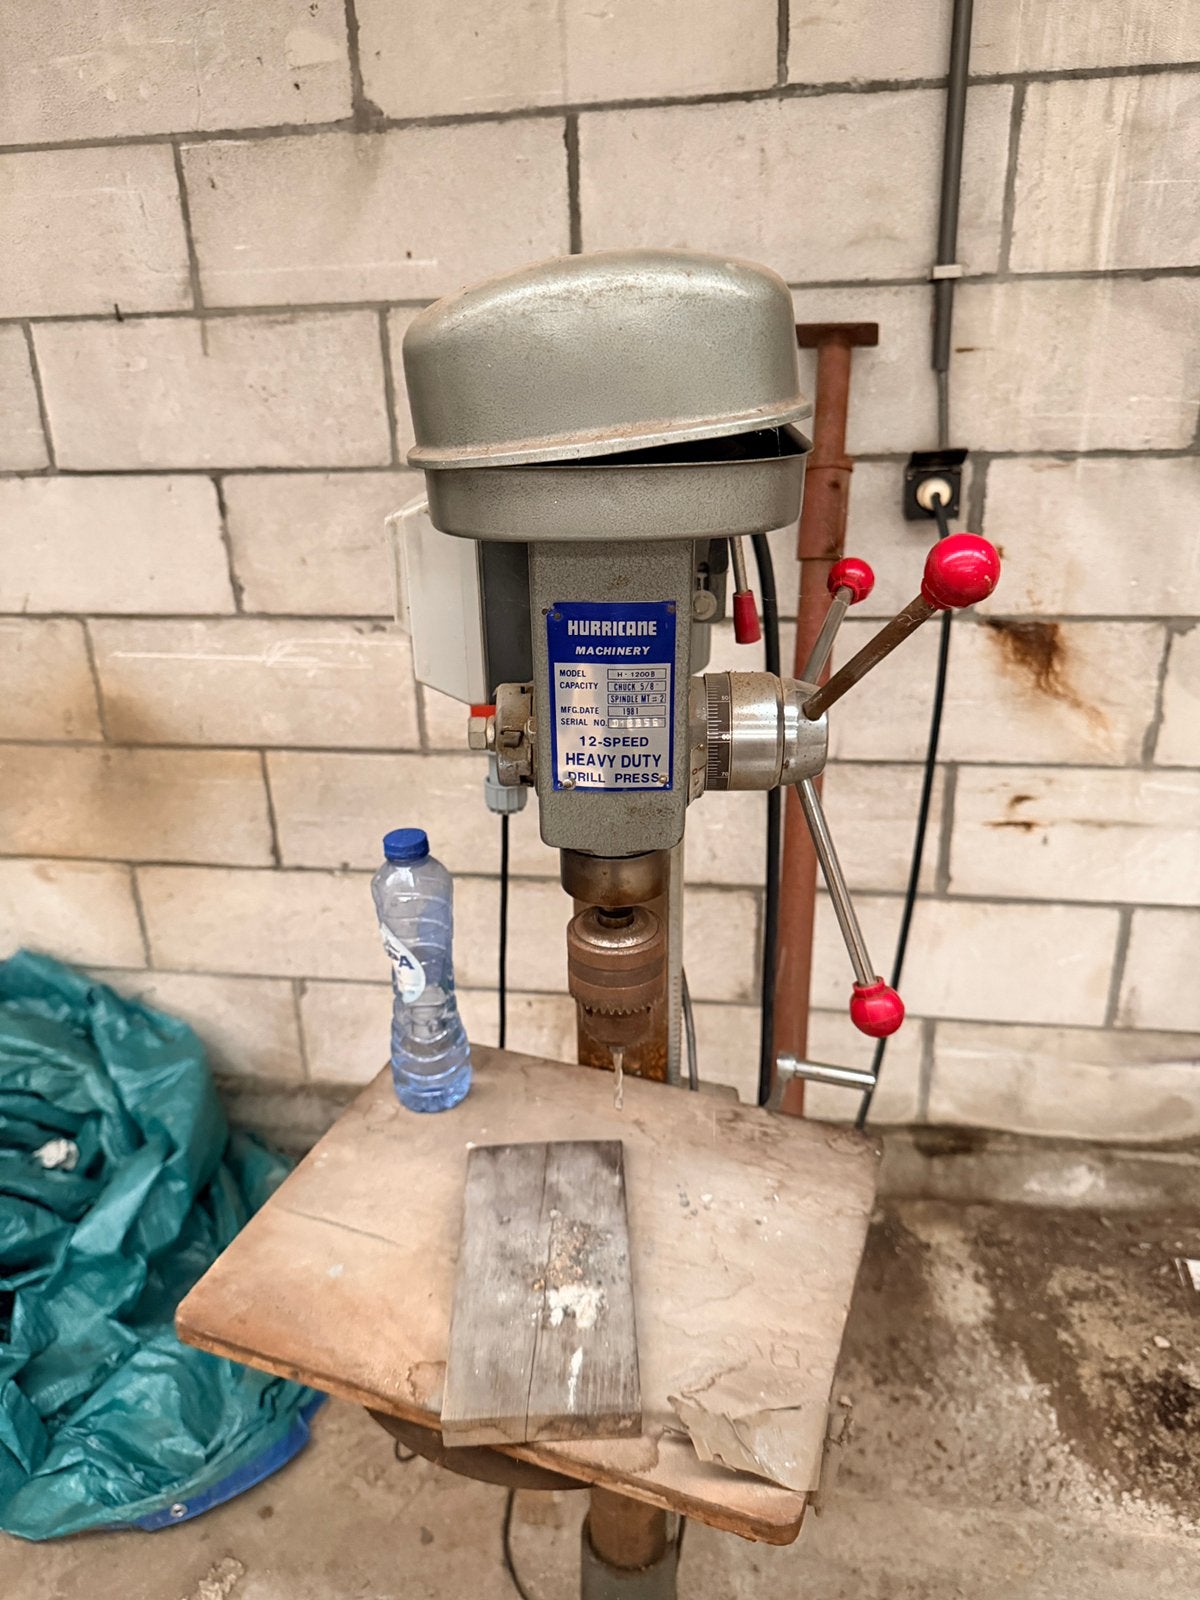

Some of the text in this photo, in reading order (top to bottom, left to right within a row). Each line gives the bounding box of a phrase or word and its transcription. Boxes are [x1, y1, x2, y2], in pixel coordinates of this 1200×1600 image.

[567, 620, 657, 636] HURRICANE
[575, 646, 650, 656] MACHINERY
[560, 669, 587, 678] MODEL
[560, 681, 599, 690] CAPACITY
[614, 683, 636, 691] CHUCK
[610, 694, 639, 703] SPINDLE
[623, 707, 639, 715] 1981
[561, 718, 588, 726] SERIAL
[579, 736, 649, 747] 12-SPEED
[565, 752, 662, 768] HEAVY DUTY
[568, 771, 660, 783] DRILL PRESS
